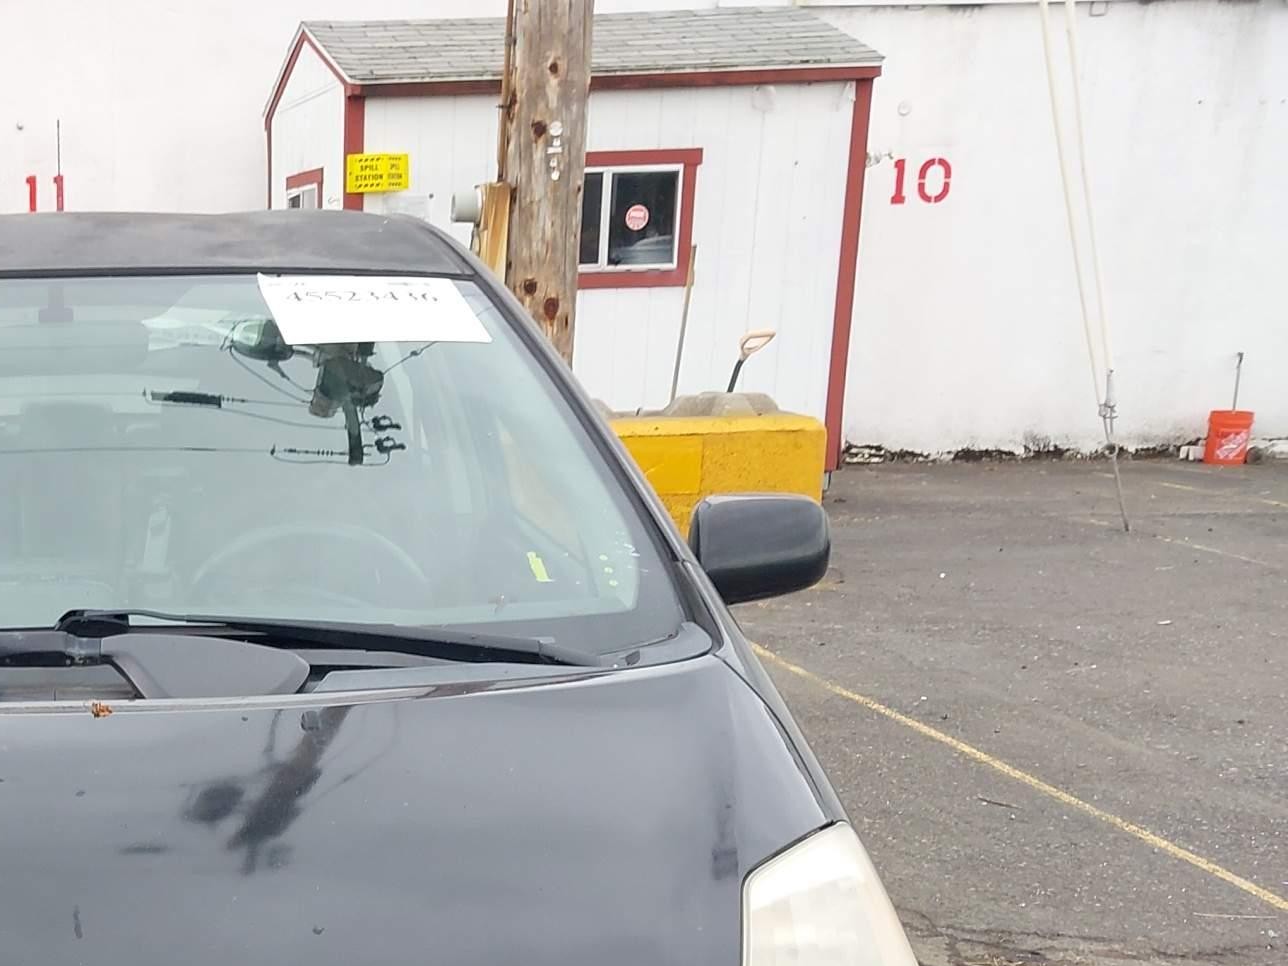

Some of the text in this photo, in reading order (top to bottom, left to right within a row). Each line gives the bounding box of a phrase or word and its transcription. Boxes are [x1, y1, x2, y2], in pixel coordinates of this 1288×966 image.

[355, 173, 384, 182] STATION
[360, 164, 379, 172] SPILL
[890, 157, 953, 206] 10
[26, 175, 65, 212] 11
